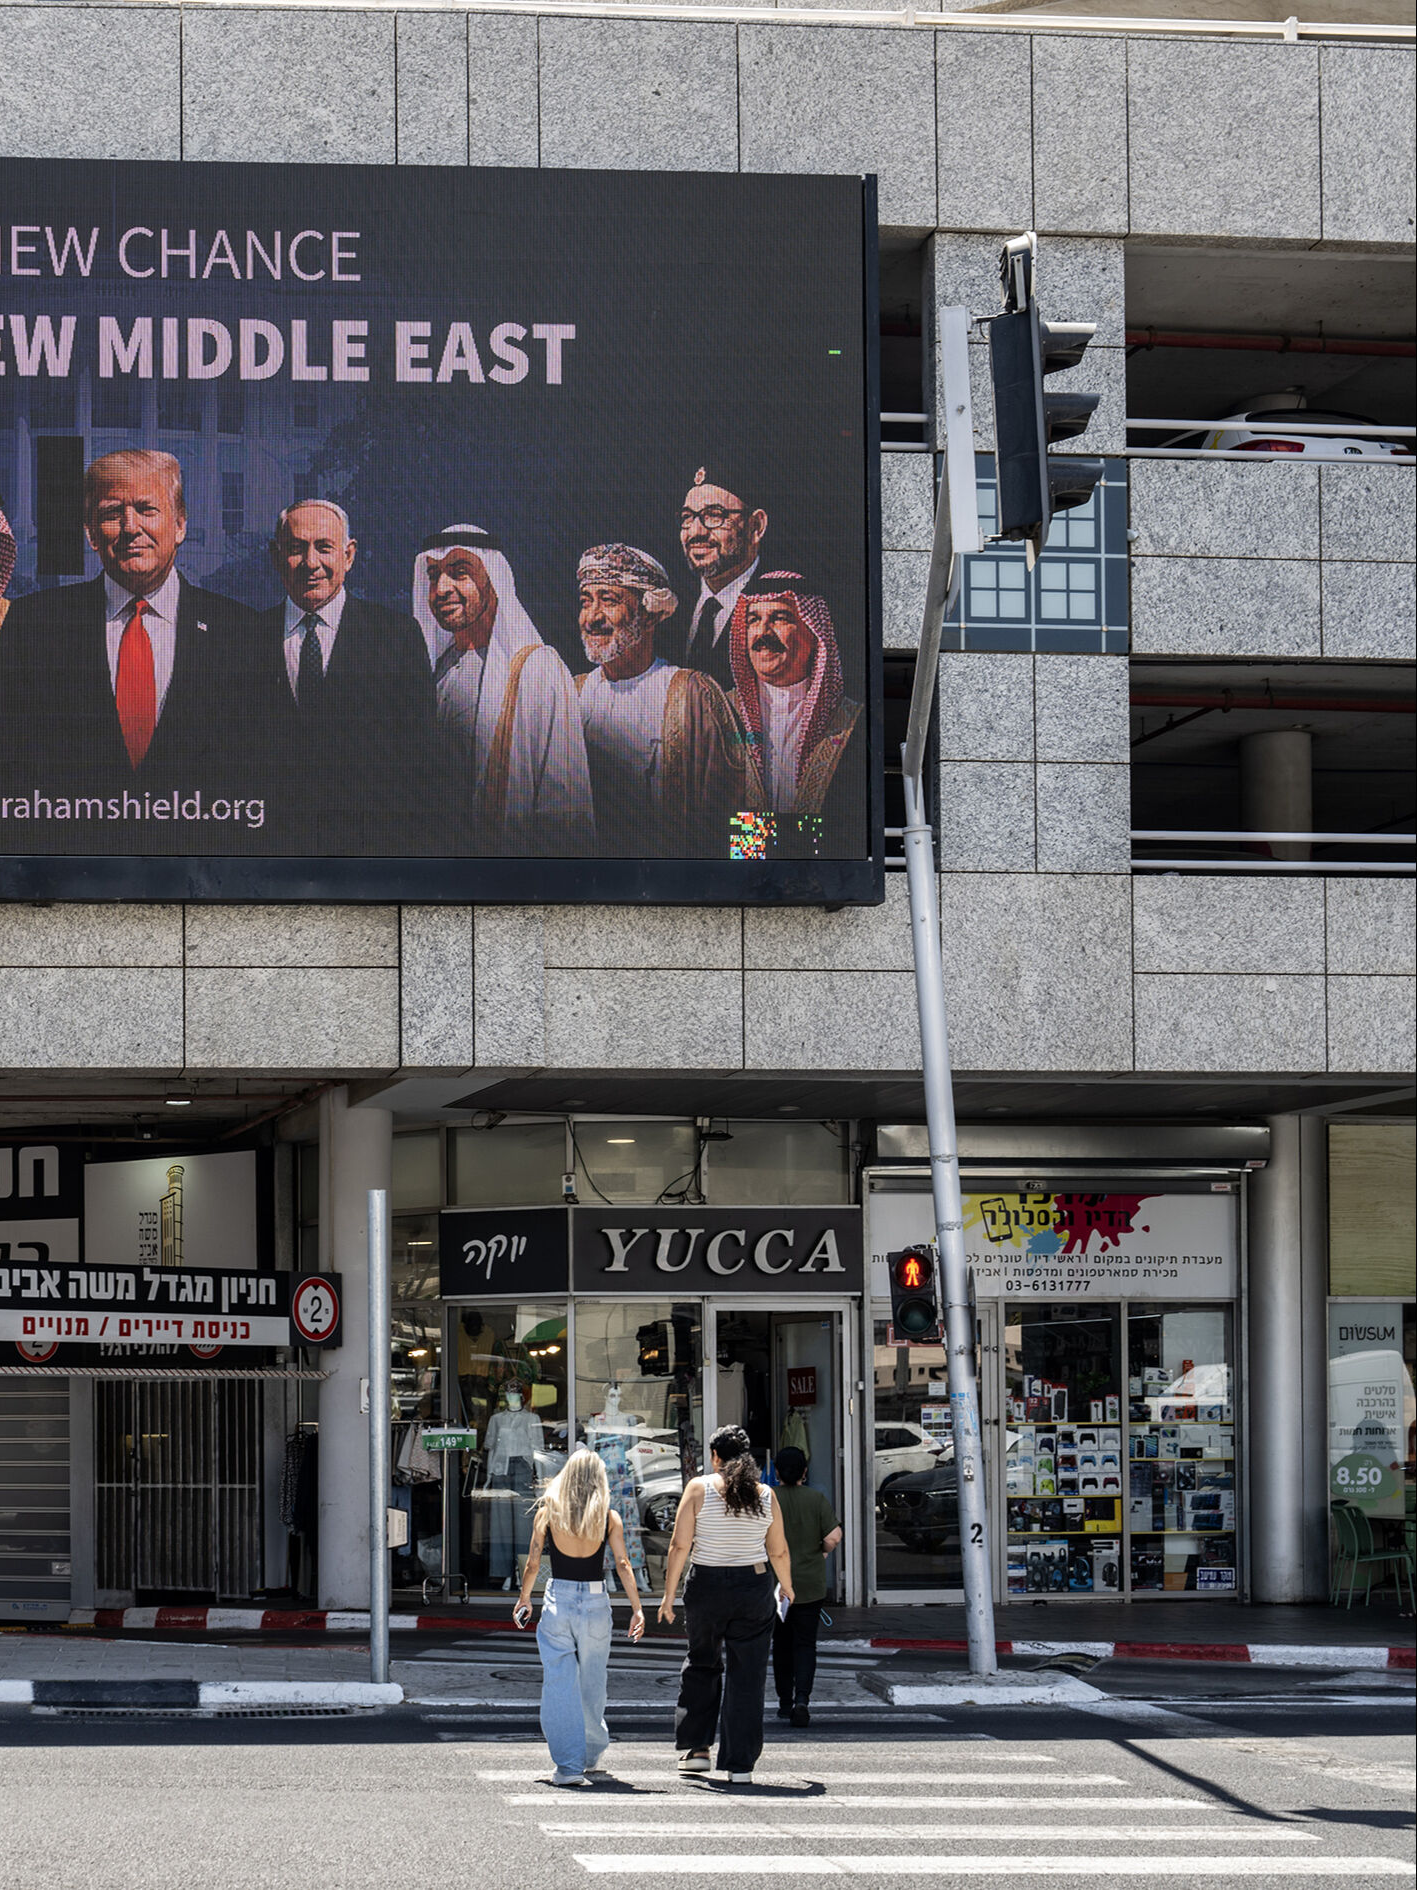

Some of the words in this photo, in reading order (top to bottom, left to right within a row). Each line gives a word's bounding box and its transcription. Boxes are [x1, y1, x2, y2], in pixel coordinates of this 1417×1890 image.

[118, 226, 362, 282] CHANCE
[98, 315, 370, 382] MIDDLE
[395, 320, 576, 385] EAST
[1084, 1210, 1132, 1227] הדיו
[462, 1234, 527, 1280] יוקה
[601, 1228, 846, 1276] YUCCA
[984, 1254, 1022, 1264] טונרים
[1034, 1254, 1049, 1264] דיו
[1053, 1254, 1082, 1264] ראשי
[1093, 1254, 1131, 1265] במקום
[1135, 1255, 1178, 1265] תיקונים
[1182, 1255, 1223, 1264] מעבדת
[1012, 1267, 1062, 1278] ומדפסות
[1067, 1267, 1139, 1278] סמארטפונים
[1142, 1268, 1178, 1278] מכירת
[68, 1271, 136, 1301] משה
[142, 1267, 214, 1304] מגדל
[221, 1275, 277, 1313] חניון
[1006, 1280, 1091, 1292] 03-6131777
[310, 1296, 323, 1322] 2
[22, 1316, 89, 1336] מנויים
[118, 1318, 184, 1338] דיירים
[191, 1320, 250, 1340] כניסת
[791, 1375, 815, 1394] SALE
[1364, 1386, 1396, 1396] סלטים
[1336, 1466, 1382, 1486] 8.50
[971, 1522, 983, 1543] 2
